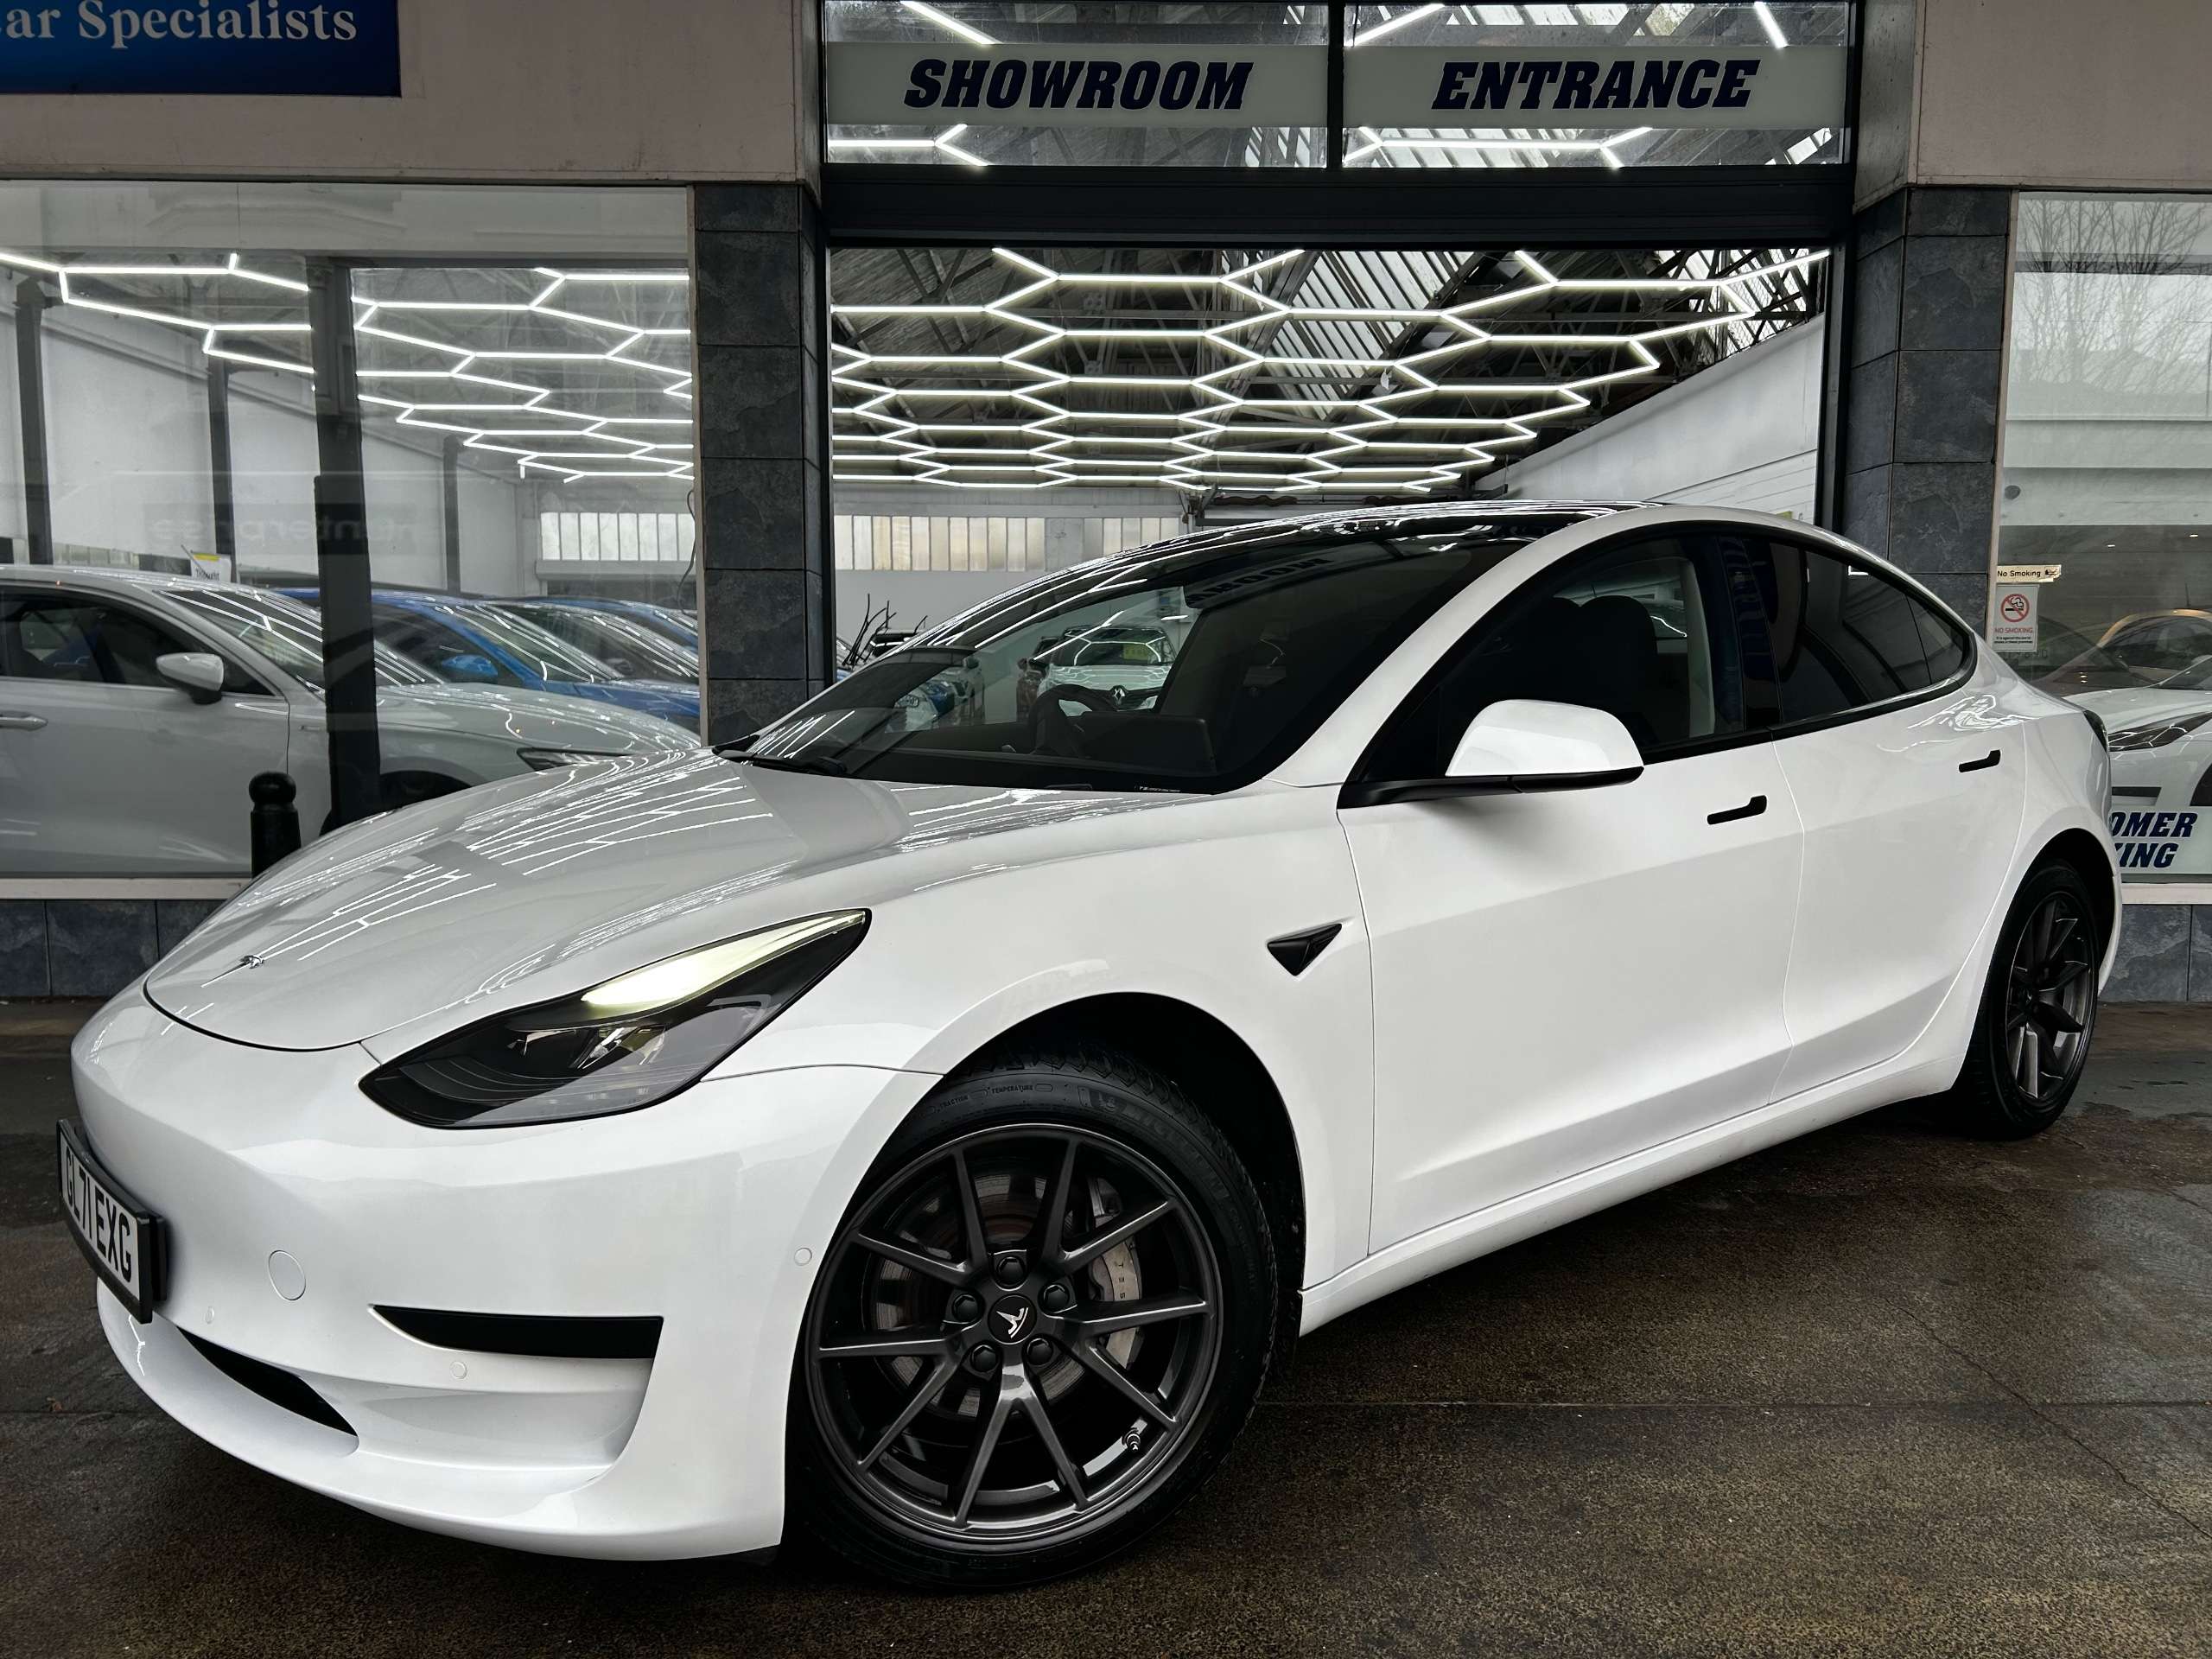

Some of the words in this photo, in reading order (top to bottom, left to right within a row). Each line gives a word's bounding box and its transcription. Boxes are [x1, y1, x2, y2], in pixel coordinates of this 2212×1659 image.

[0, 8, 61, 38] ar
[79, 0, 357, 48] Specialists
[904, 59, 1255, 110] SHOWROOM
[1431, 60, 1761, 110] ENTRANCE
[2010, 569, 2041, 578] Smoking
[992, 1084, 1033, 1094] TEMPERATURE
[66, 1146, 92, 1240] GL71
[94, 1185, 131, 1283] EXG
